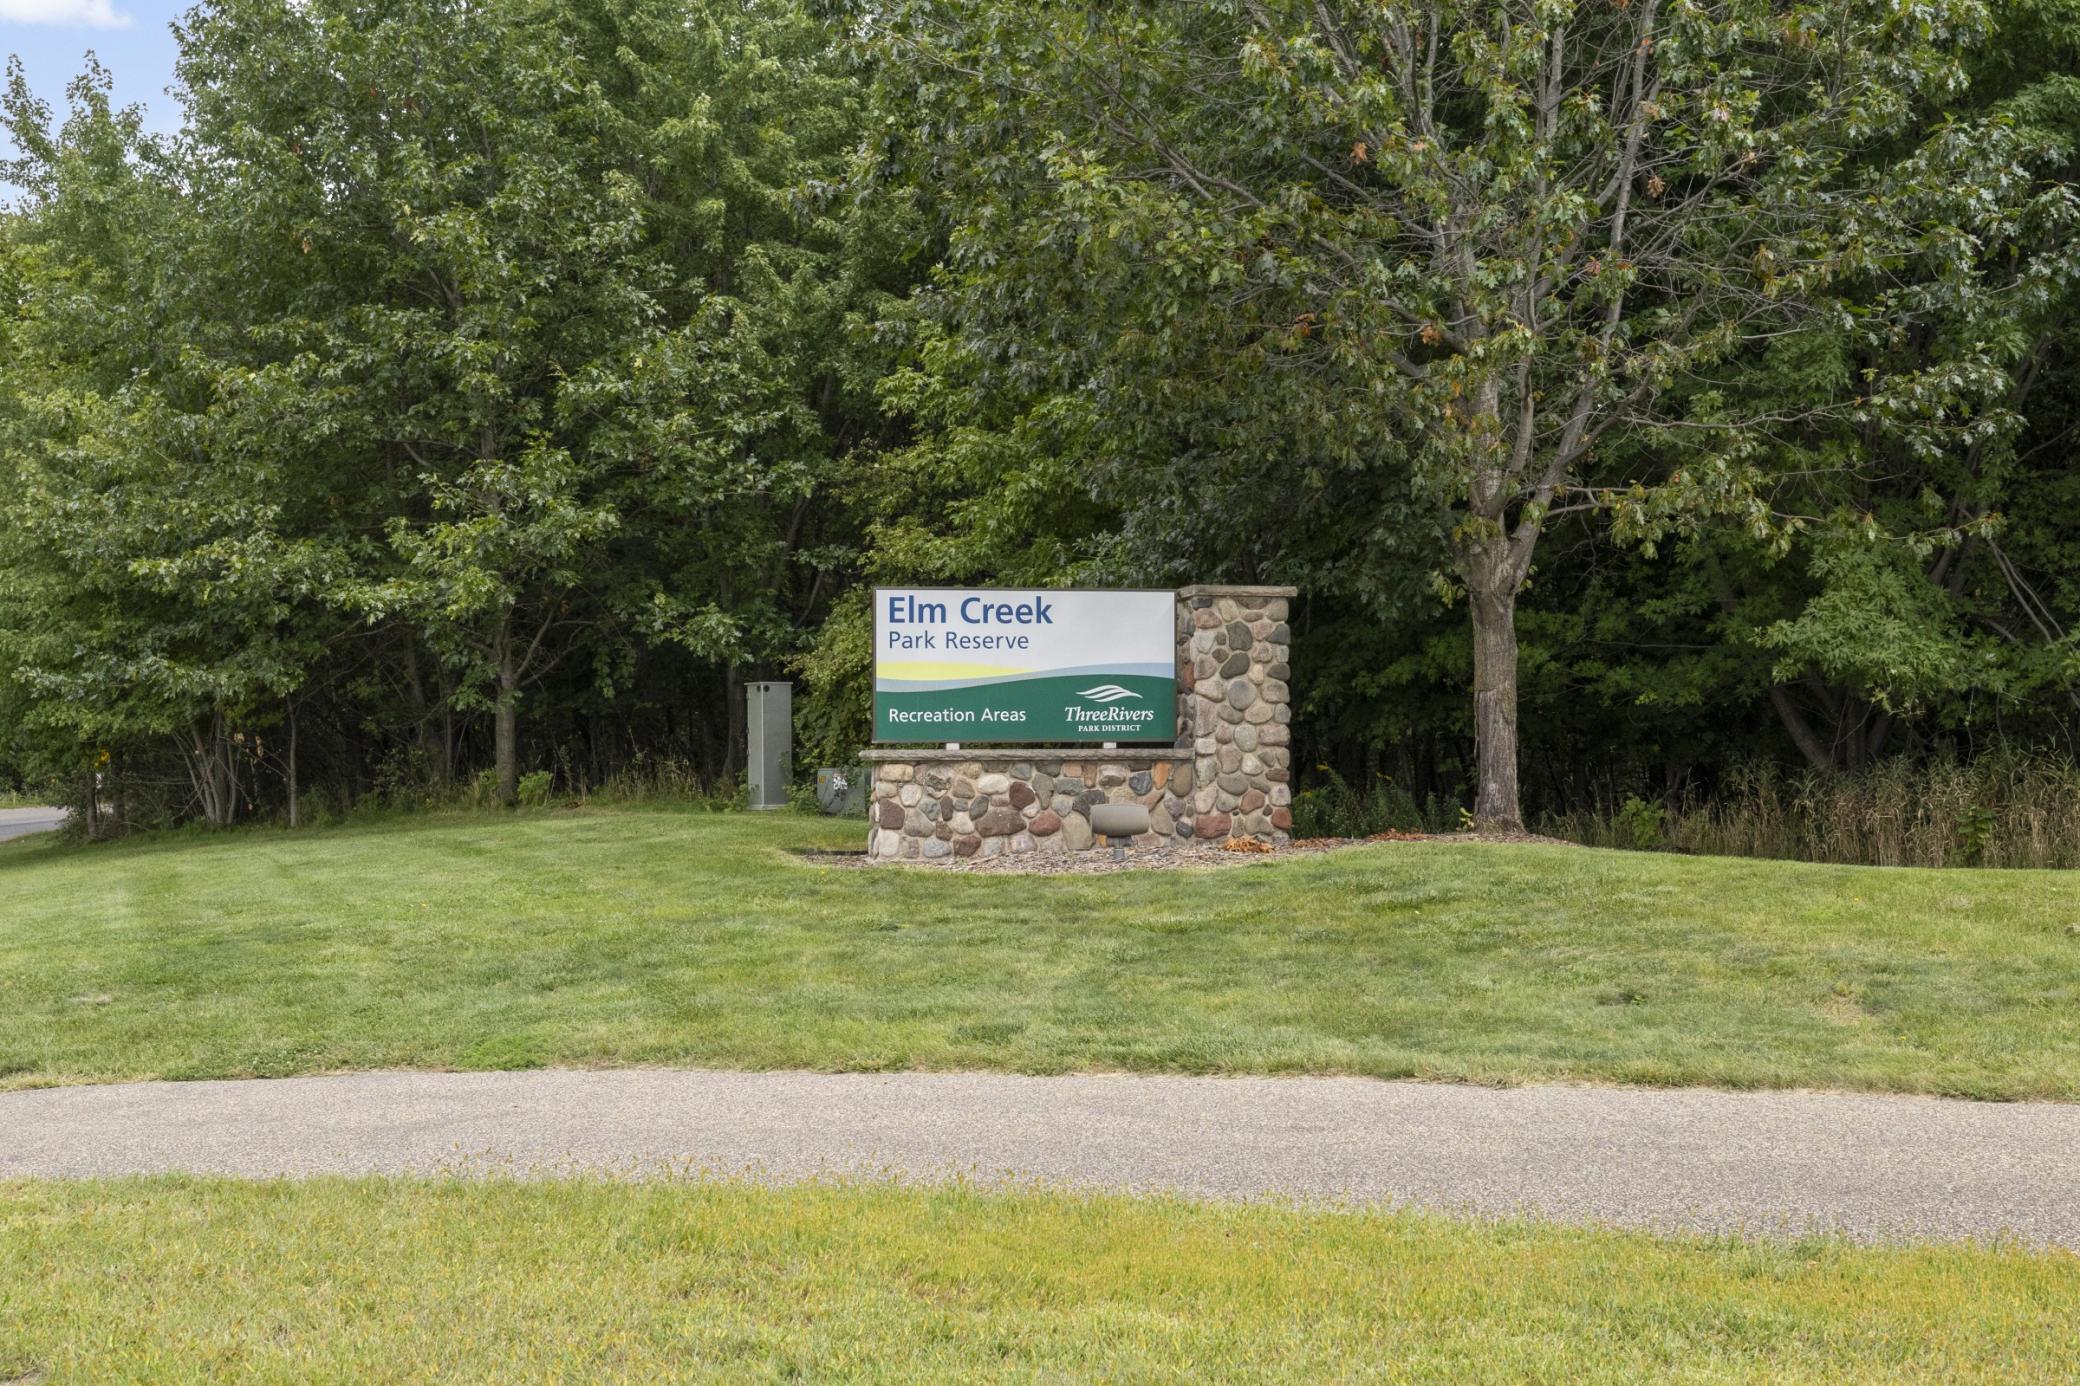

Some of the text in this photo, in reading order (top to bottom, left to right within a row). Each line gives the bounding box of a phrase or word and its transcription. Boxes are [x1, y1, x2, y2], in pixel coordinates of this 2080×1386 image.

[889, 595, 1053, 624] Elm Creek
[889, 631, 1029, 649] Park Reserve
[889, 708, 1026, 722] Recreation Areas
[1064, 706, 1154, 722] ThreeRivers
